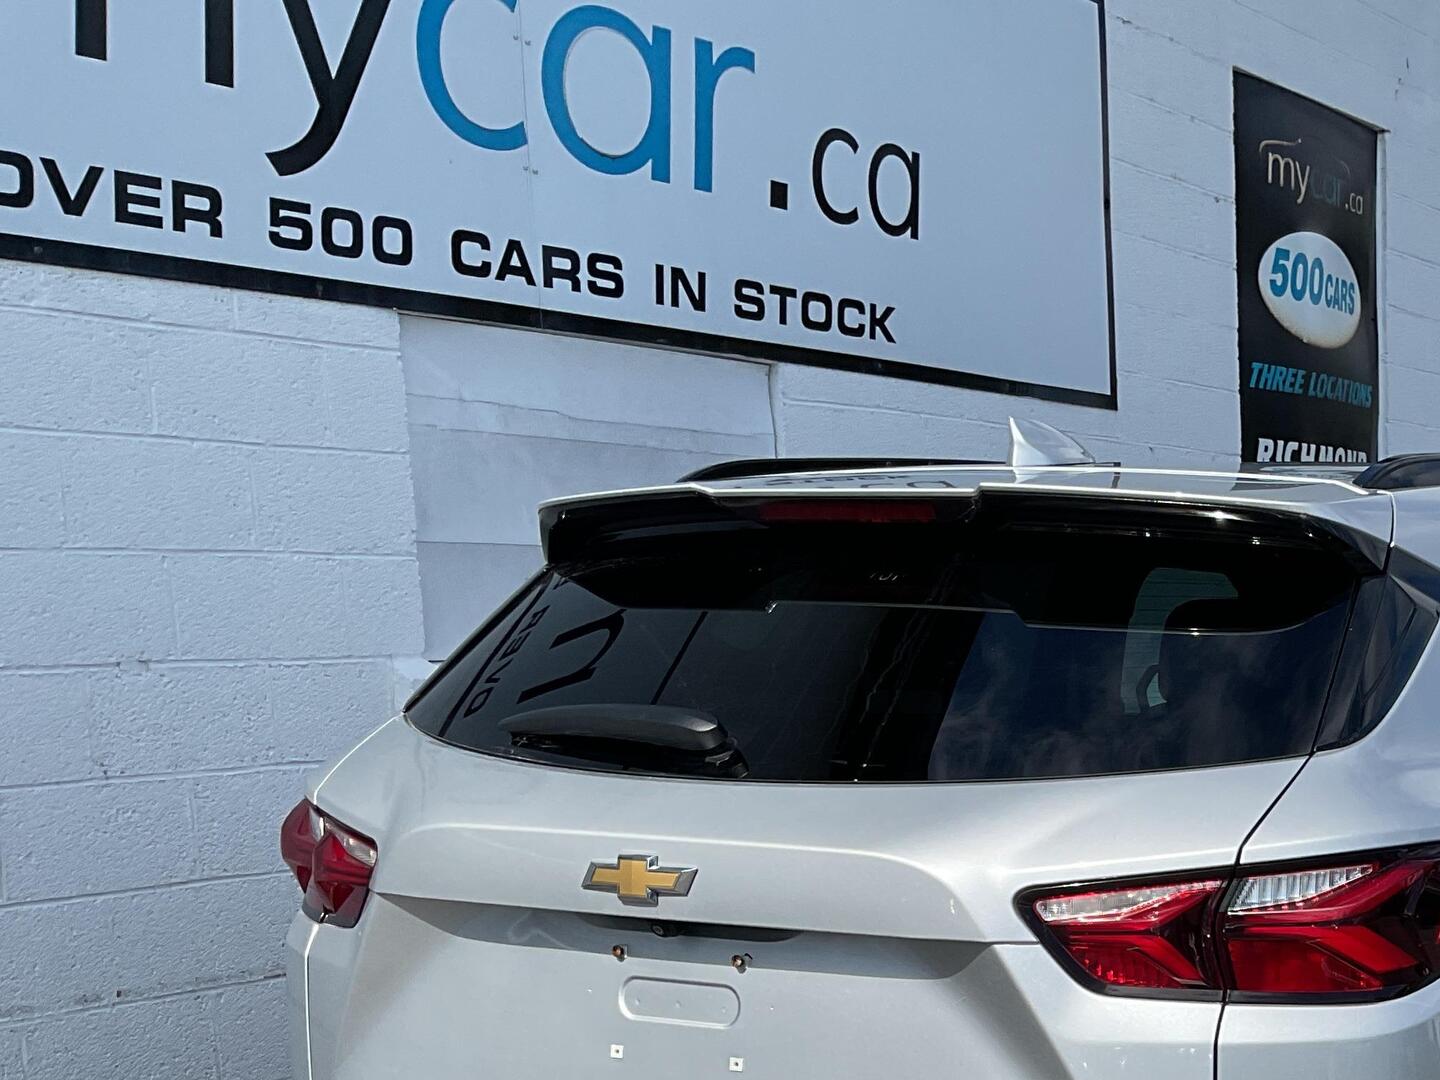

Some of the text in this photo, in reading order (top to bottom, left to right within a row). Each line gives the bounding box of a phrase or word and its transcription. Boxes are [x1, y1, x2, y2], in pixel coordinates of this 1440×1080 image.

[75, 0, 920, 241] ycar.ca
[0, 149, 897, 344] OVER 500 CARS IN STOCK
[1269, 247, 1355, 316] 500 CARS
[1249, 361, 1373, 409] THREE LOCATIONS
